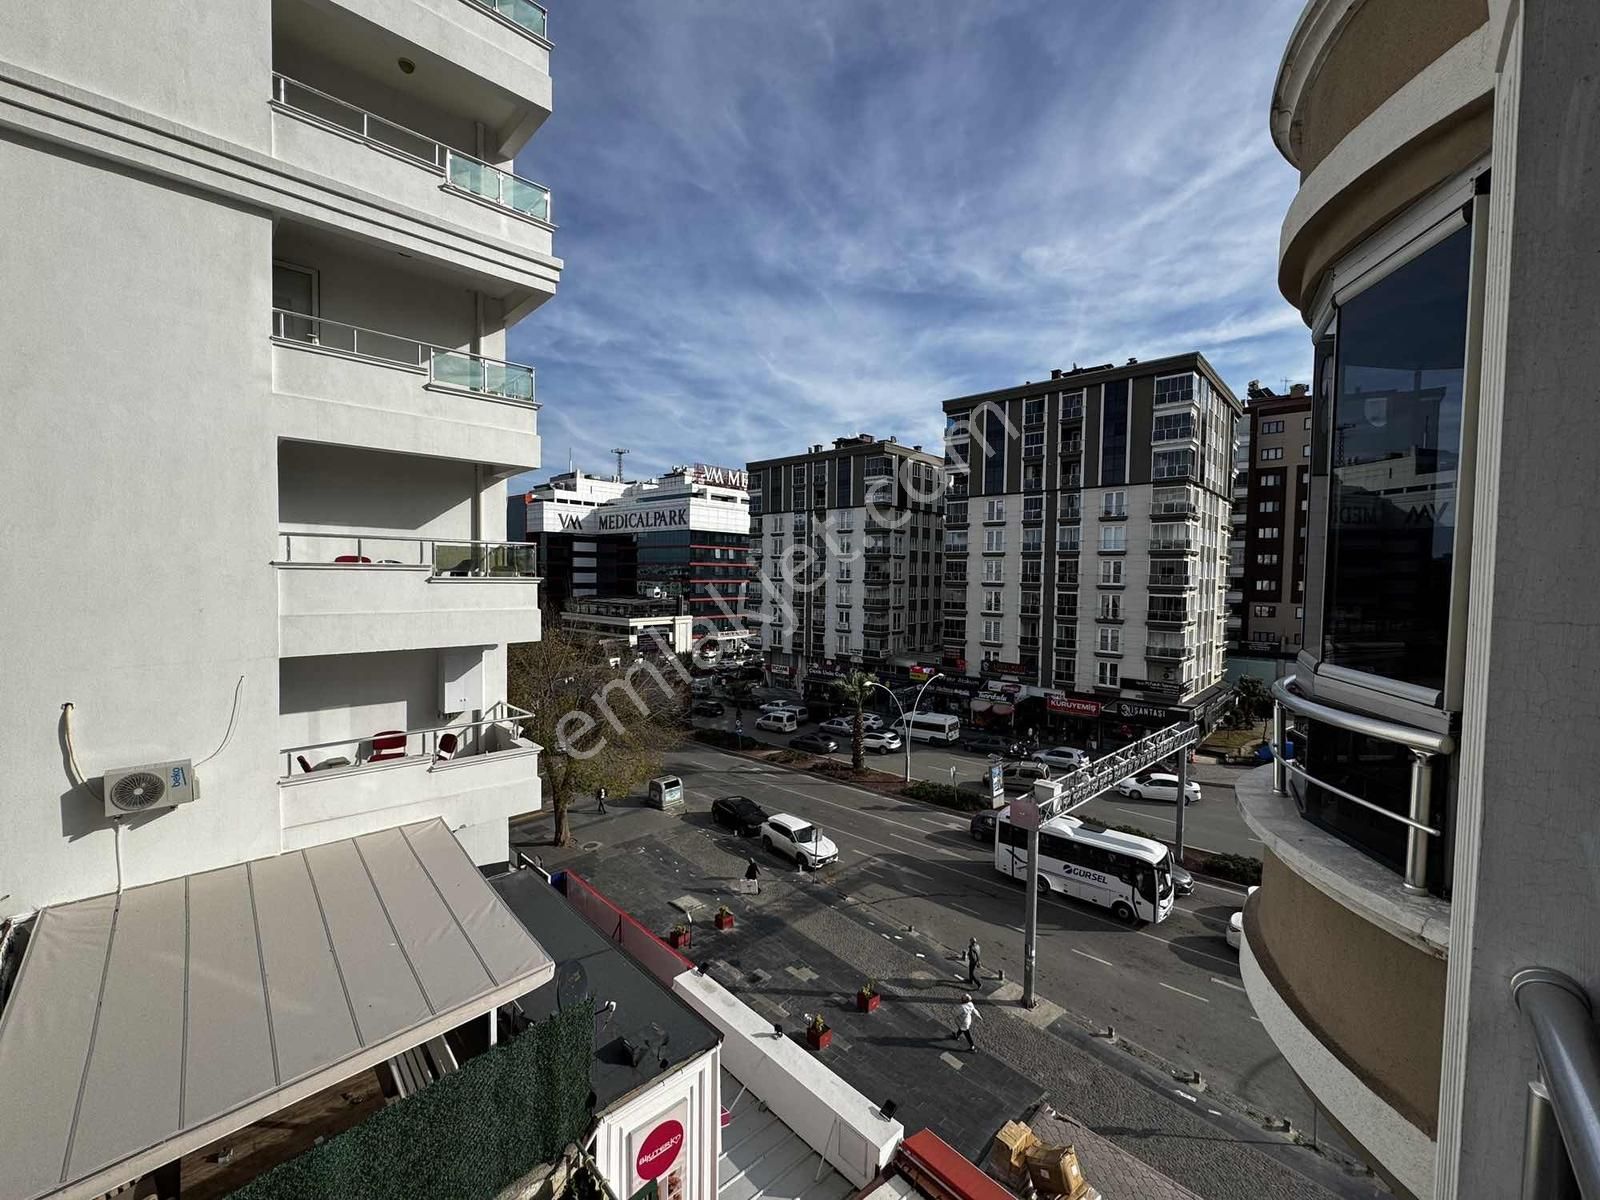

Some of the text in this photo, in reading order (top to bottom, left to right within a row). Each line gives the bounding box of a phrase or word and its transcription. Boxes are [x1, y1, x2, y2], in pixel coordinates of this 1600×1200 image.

[599, 508, 688, 530] MEDICALPARK
[1050, 699, 1096, 713] KURUYEMİŞ
[171, 767, 181, 788] beko
